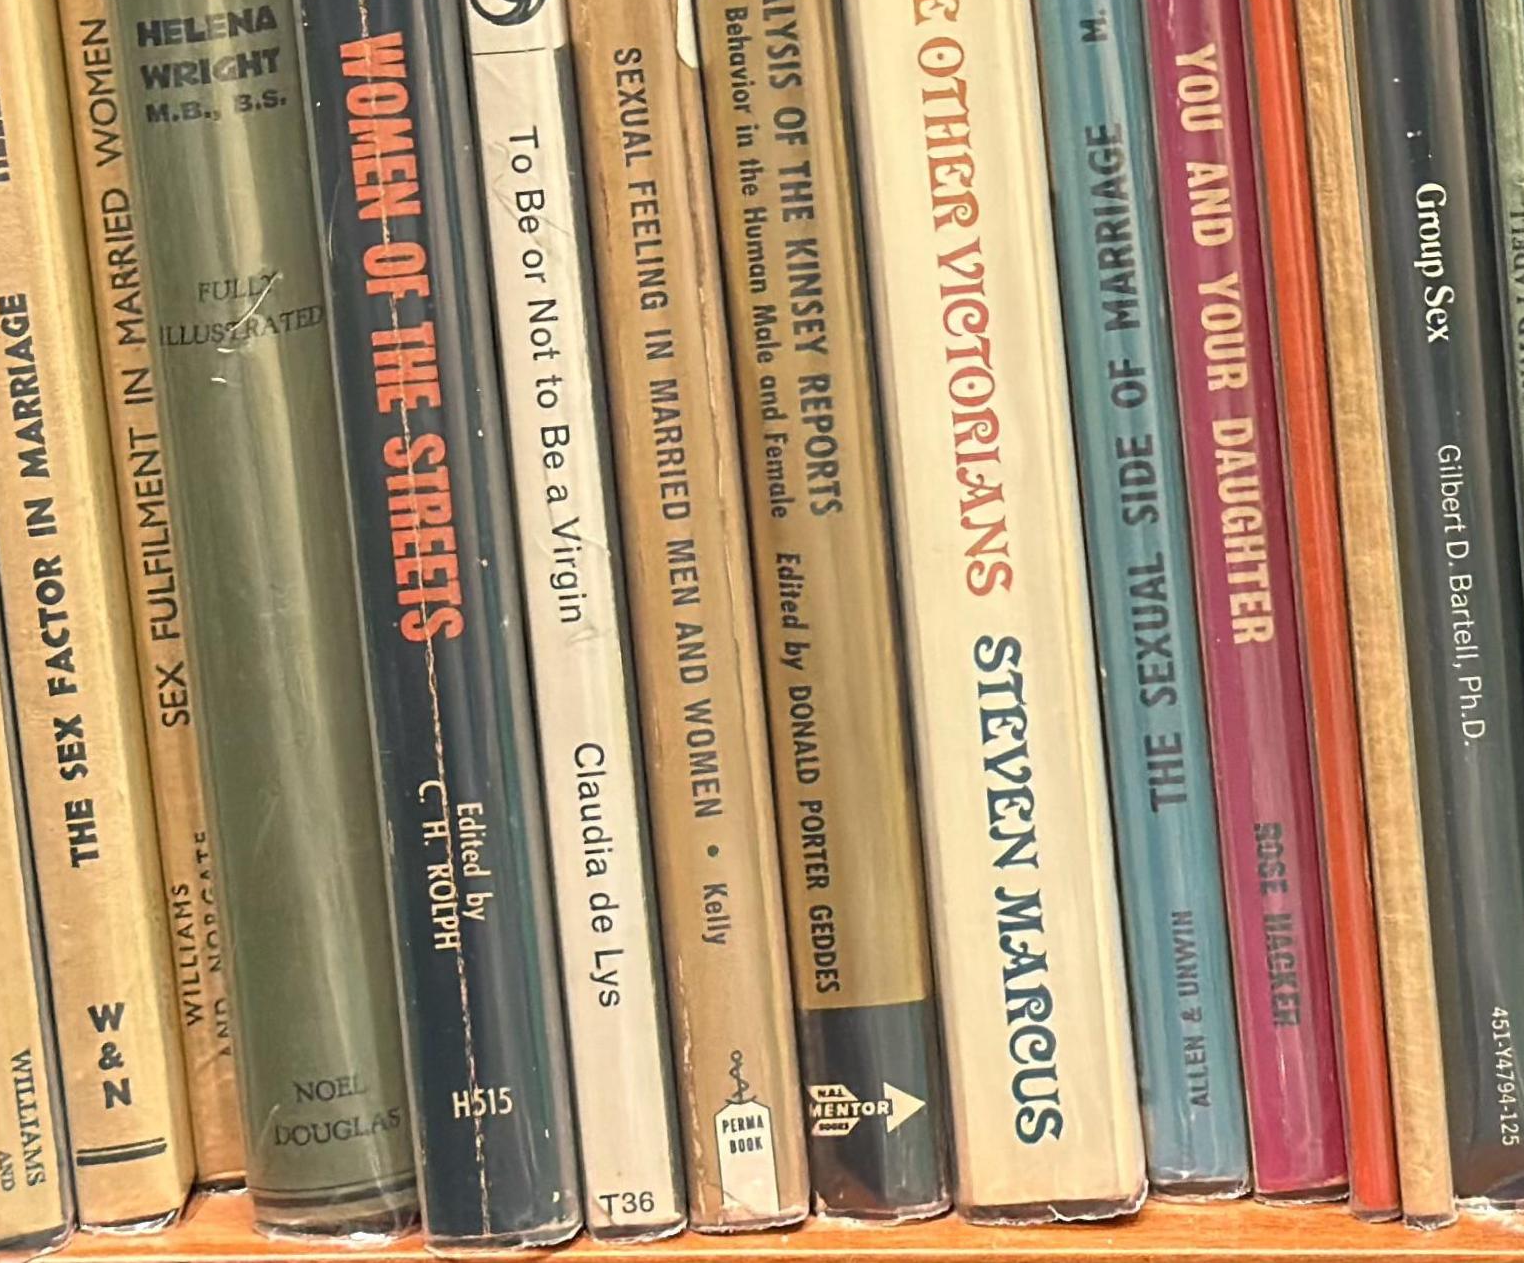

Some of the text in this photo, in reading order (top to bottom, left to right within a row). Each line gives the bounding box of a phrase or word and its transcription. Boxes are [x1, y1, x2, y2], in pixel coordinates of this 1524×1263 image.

[1413, 183, 1455, 342] Group Sex
[508, 126, 620, 1010] To Be or Not to Be a Virgin Claudia de Lys
[1437, 444, 1485, 744] Gilbert D. Bartell, Ph.D.
[422, 814, 450, 847] H.
[456, 800, 494, 920] Edited by
[428, 863, 461, 950] ROLPH
[453, 1086, 513, 1119] H515
[722, 1116, 764, 1136] PERMA
[728, 1137, 763, 1154] BOOK
[598, 1190, 655, 1217] T36
